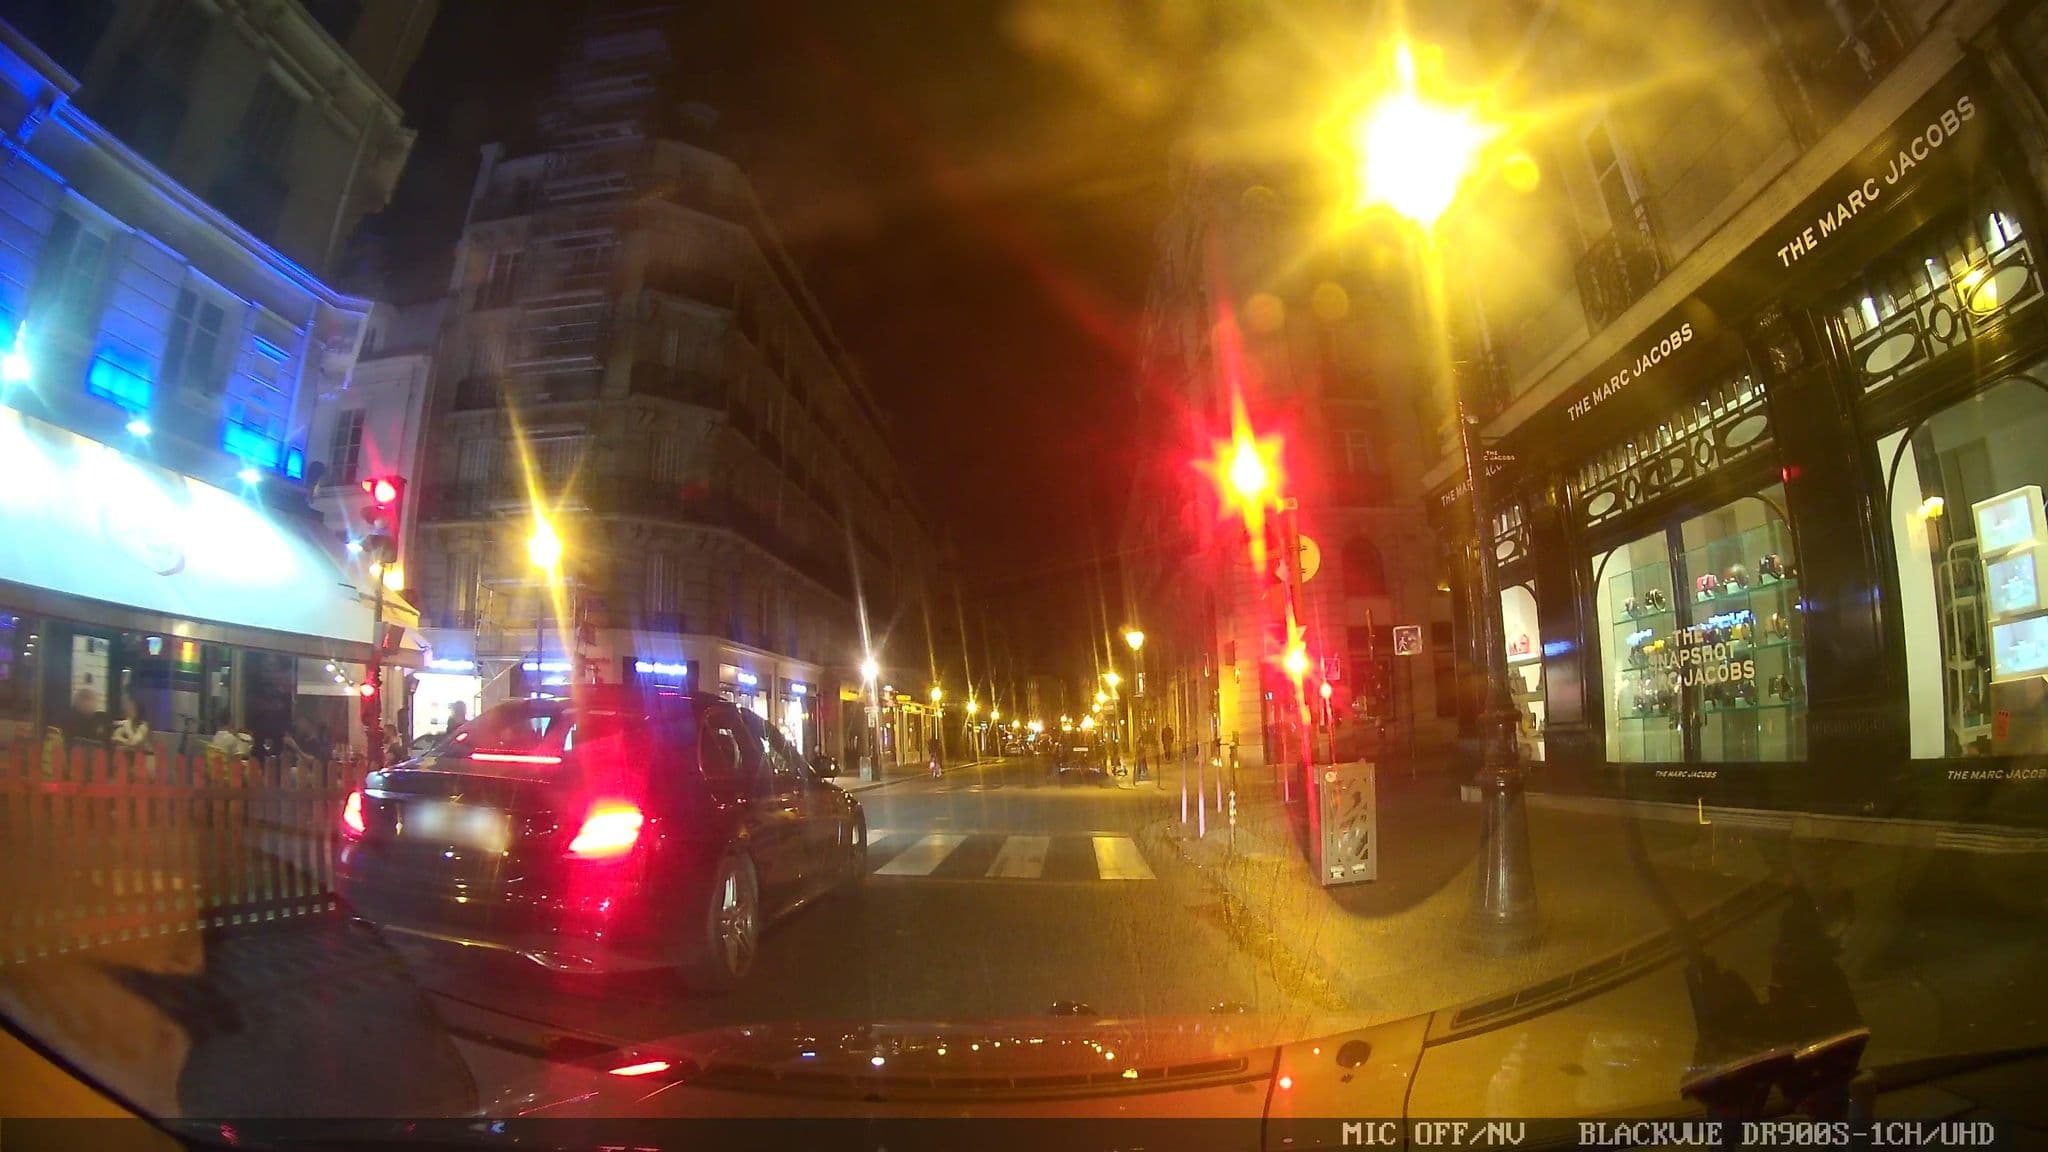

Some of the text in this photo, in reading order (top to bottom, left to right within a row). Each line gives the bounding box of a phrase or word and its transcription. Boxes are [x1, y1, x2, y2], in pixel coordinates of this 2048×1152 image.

[1777, 95, 1976, 267] THE MARC JACOBS
[1567, 323, 1693, 421] THE MARC JACOBS
[1440, 489, 1456, 508] THE
[1455, 479, 1474, 498] MAR
[1672, 628, 1705, 647] THE
[1684, 660, 1756, 687] JACOBS
[1947, 770, 1970, 780] THE
[1970, 769, 2004, 780] MARC
